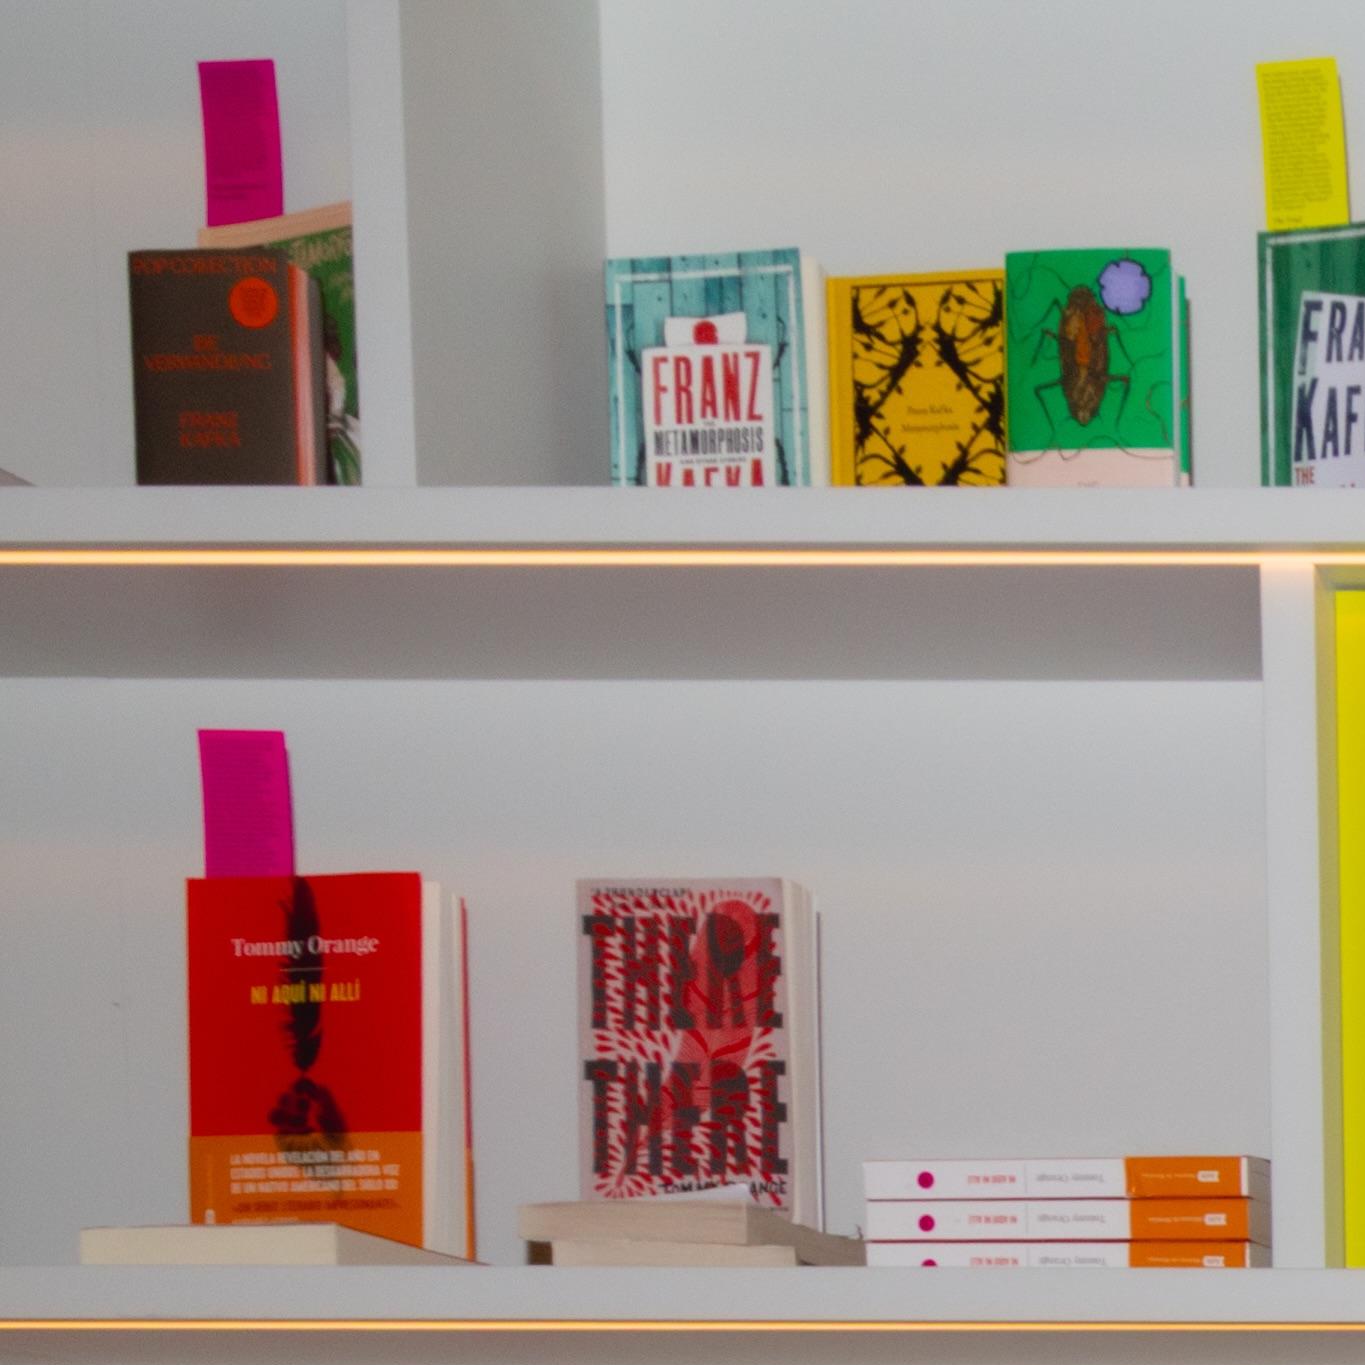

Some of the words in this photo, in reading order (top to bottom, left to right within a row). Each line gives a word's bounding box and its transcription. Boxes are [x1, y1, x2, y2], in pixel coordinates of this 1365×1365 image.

[652, 351, 763, 426] FRANZ
[654, 426, 763, 456] METAMORPHOSIS
[231, 937, 302, 958] Tommy
[307, 934, 380, 956] Orange
[250, 986, 267, 1005] NI
[272, 979, 306, 1004] AQUÍ
[310, 983, 326, 1004] NI
[330, 980, 360, 1003] ALLÍ
